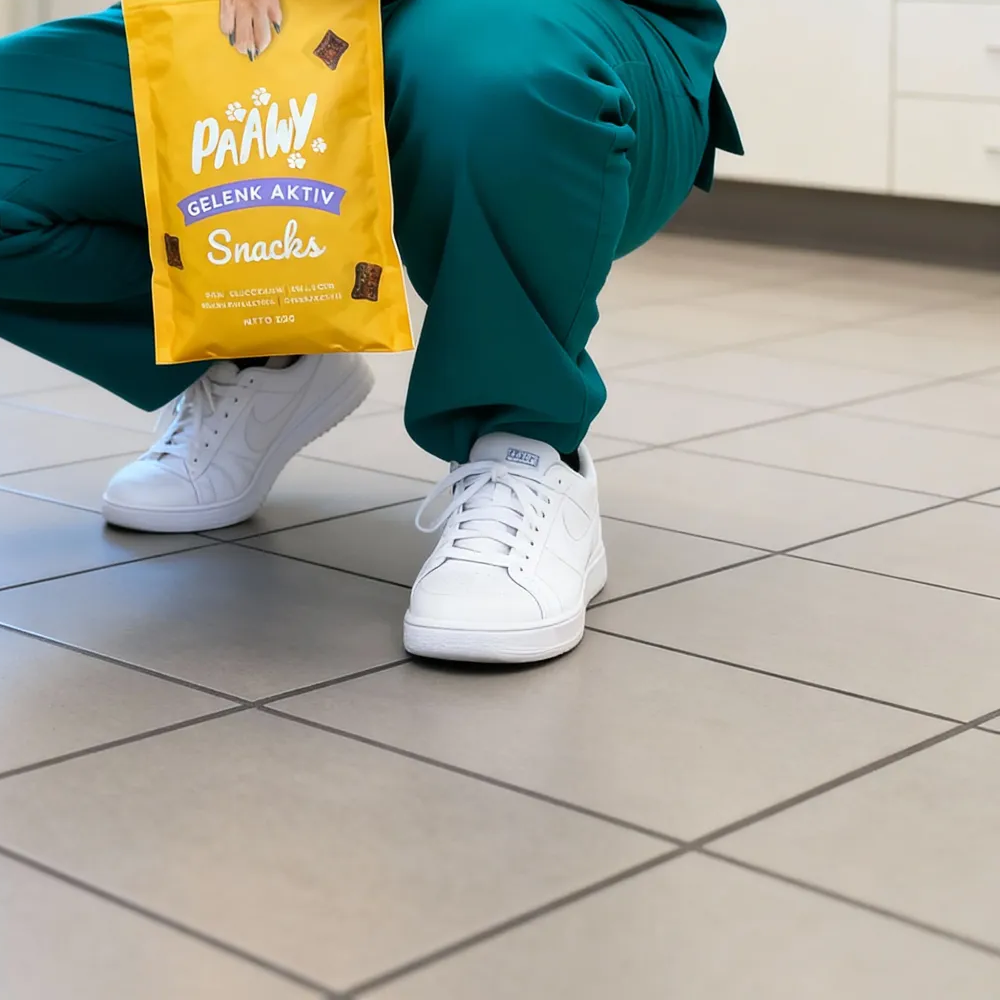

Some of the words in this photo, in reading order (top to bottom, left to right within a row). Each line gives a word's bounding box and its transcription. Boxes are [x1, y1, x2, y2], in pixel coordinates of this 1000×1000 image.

[187, 185, 262, 217] GELENK
[271, 184, 334, 205] AKTIV
[207, 219, 326, 265] Snacks
